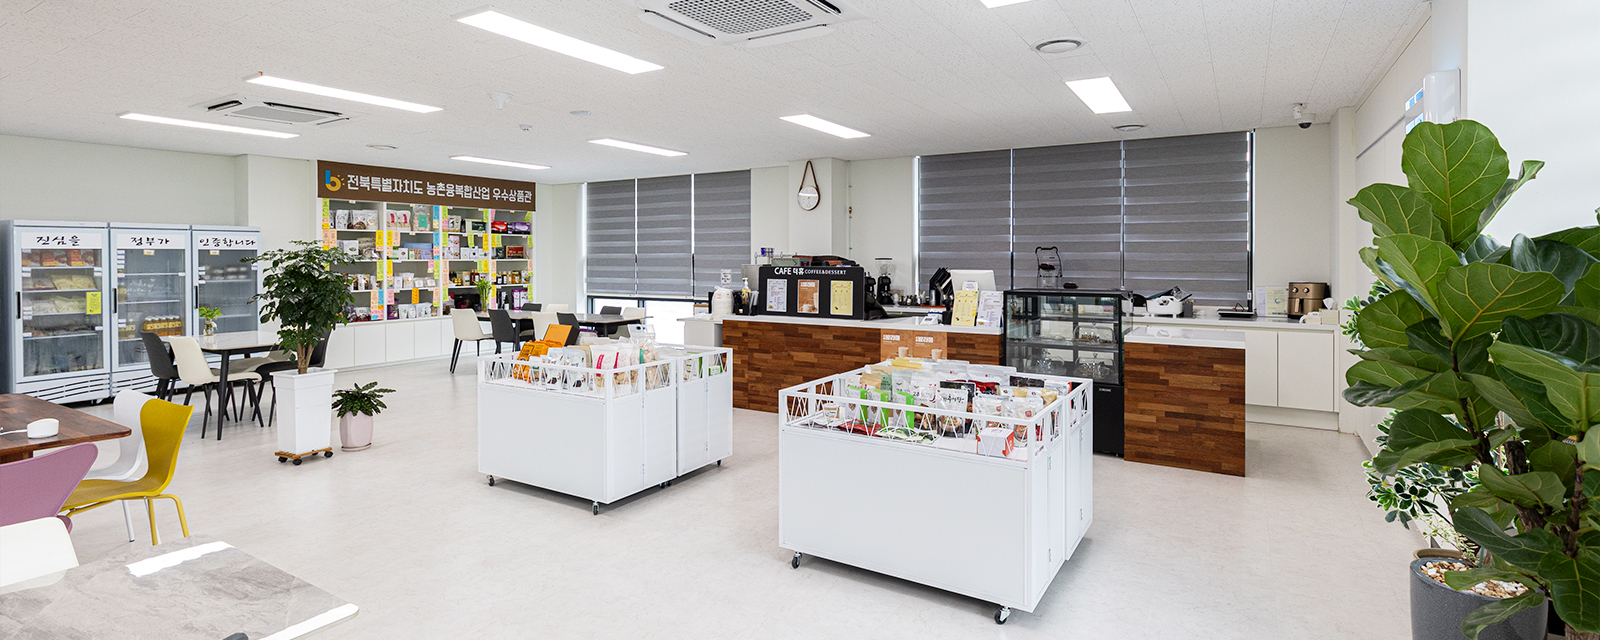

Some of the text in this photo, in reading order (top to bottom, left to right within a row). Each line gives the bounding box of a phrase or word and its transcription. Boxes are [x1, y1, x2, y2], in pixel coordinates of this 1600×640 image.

[347, 174, 532, 203] 전북특별자치도 농촌융복합산업 우수상품관
[36, 235, 81, 247] 진심을
[130, 236, 170, 246] 정부가
[199, 237, 256, 248] 인증합니다
[774, 267, 792, 275] CAFE
